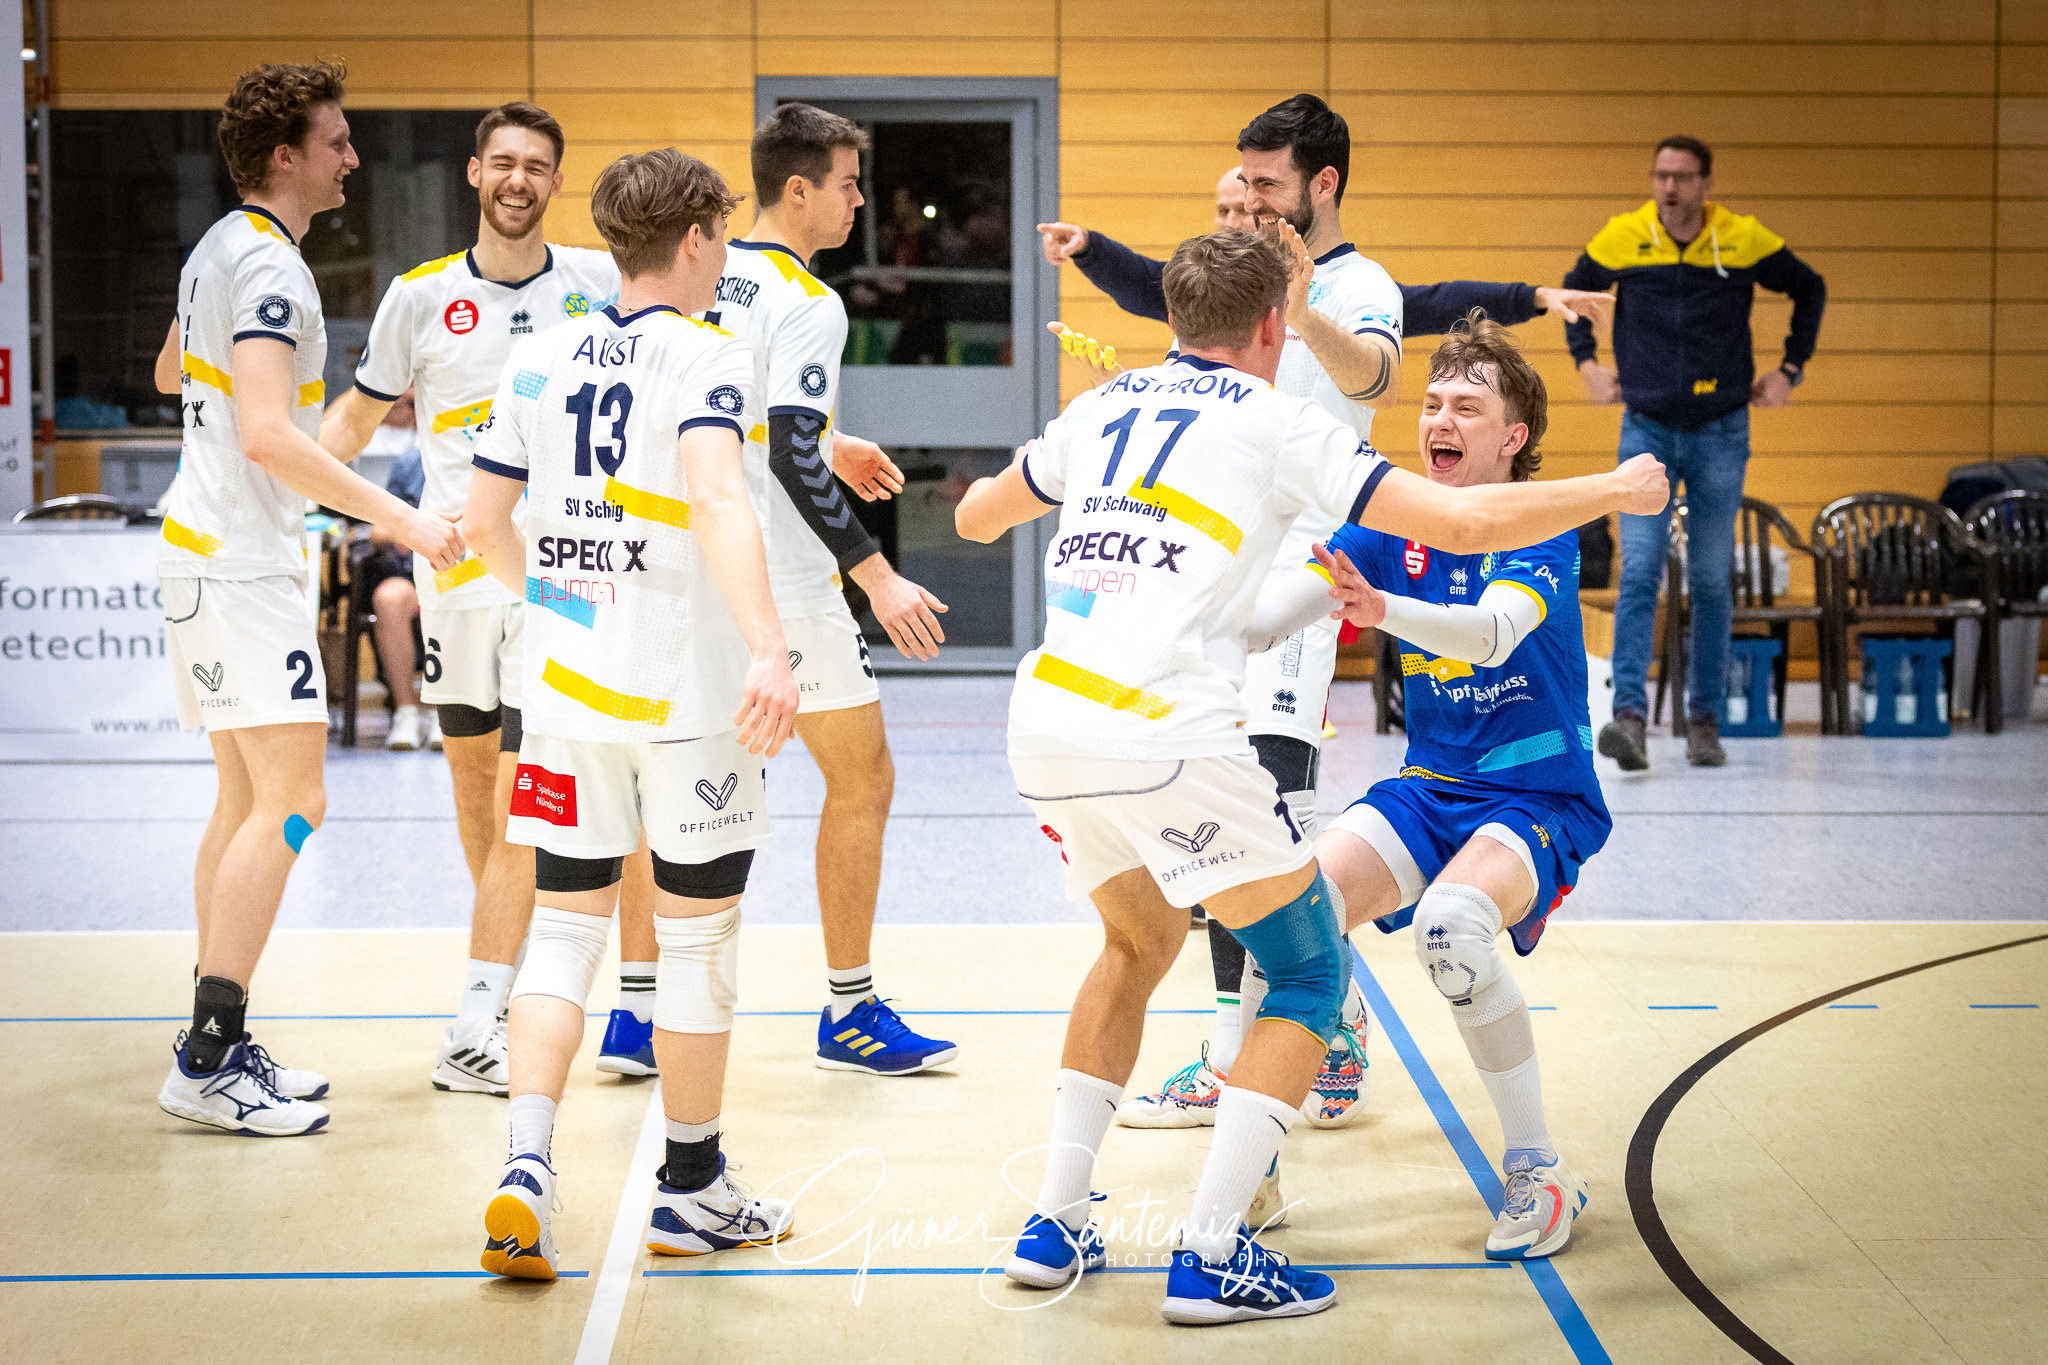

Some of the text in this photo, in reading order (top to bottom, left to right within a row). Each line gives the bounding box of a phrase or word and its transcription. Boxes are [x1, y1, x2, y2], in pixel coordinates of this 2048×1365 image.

[510, 324, 533, 334] errea
[573, 334, 643, 368] AUST
[565, 382, 633, 477] 13
[1101, 408, 1200, 489] 17
[565, 498, 580, 516] SV
[1083, 495, 1168, 522] SV Schwaig
[538, 536, 614, 572] SPECK
[1054, 531, 1149, 568] SPECK
[286, 650, 318, 700] 2
[424, 637, 443, 684] 6
[1272, 703, 1296, 714] errea
[679, 811, 754, 833] OFFICEWELT
[1162, 850, 1247, 882] OFFICEWELT
[1427, 941, 1451, 950] errea
